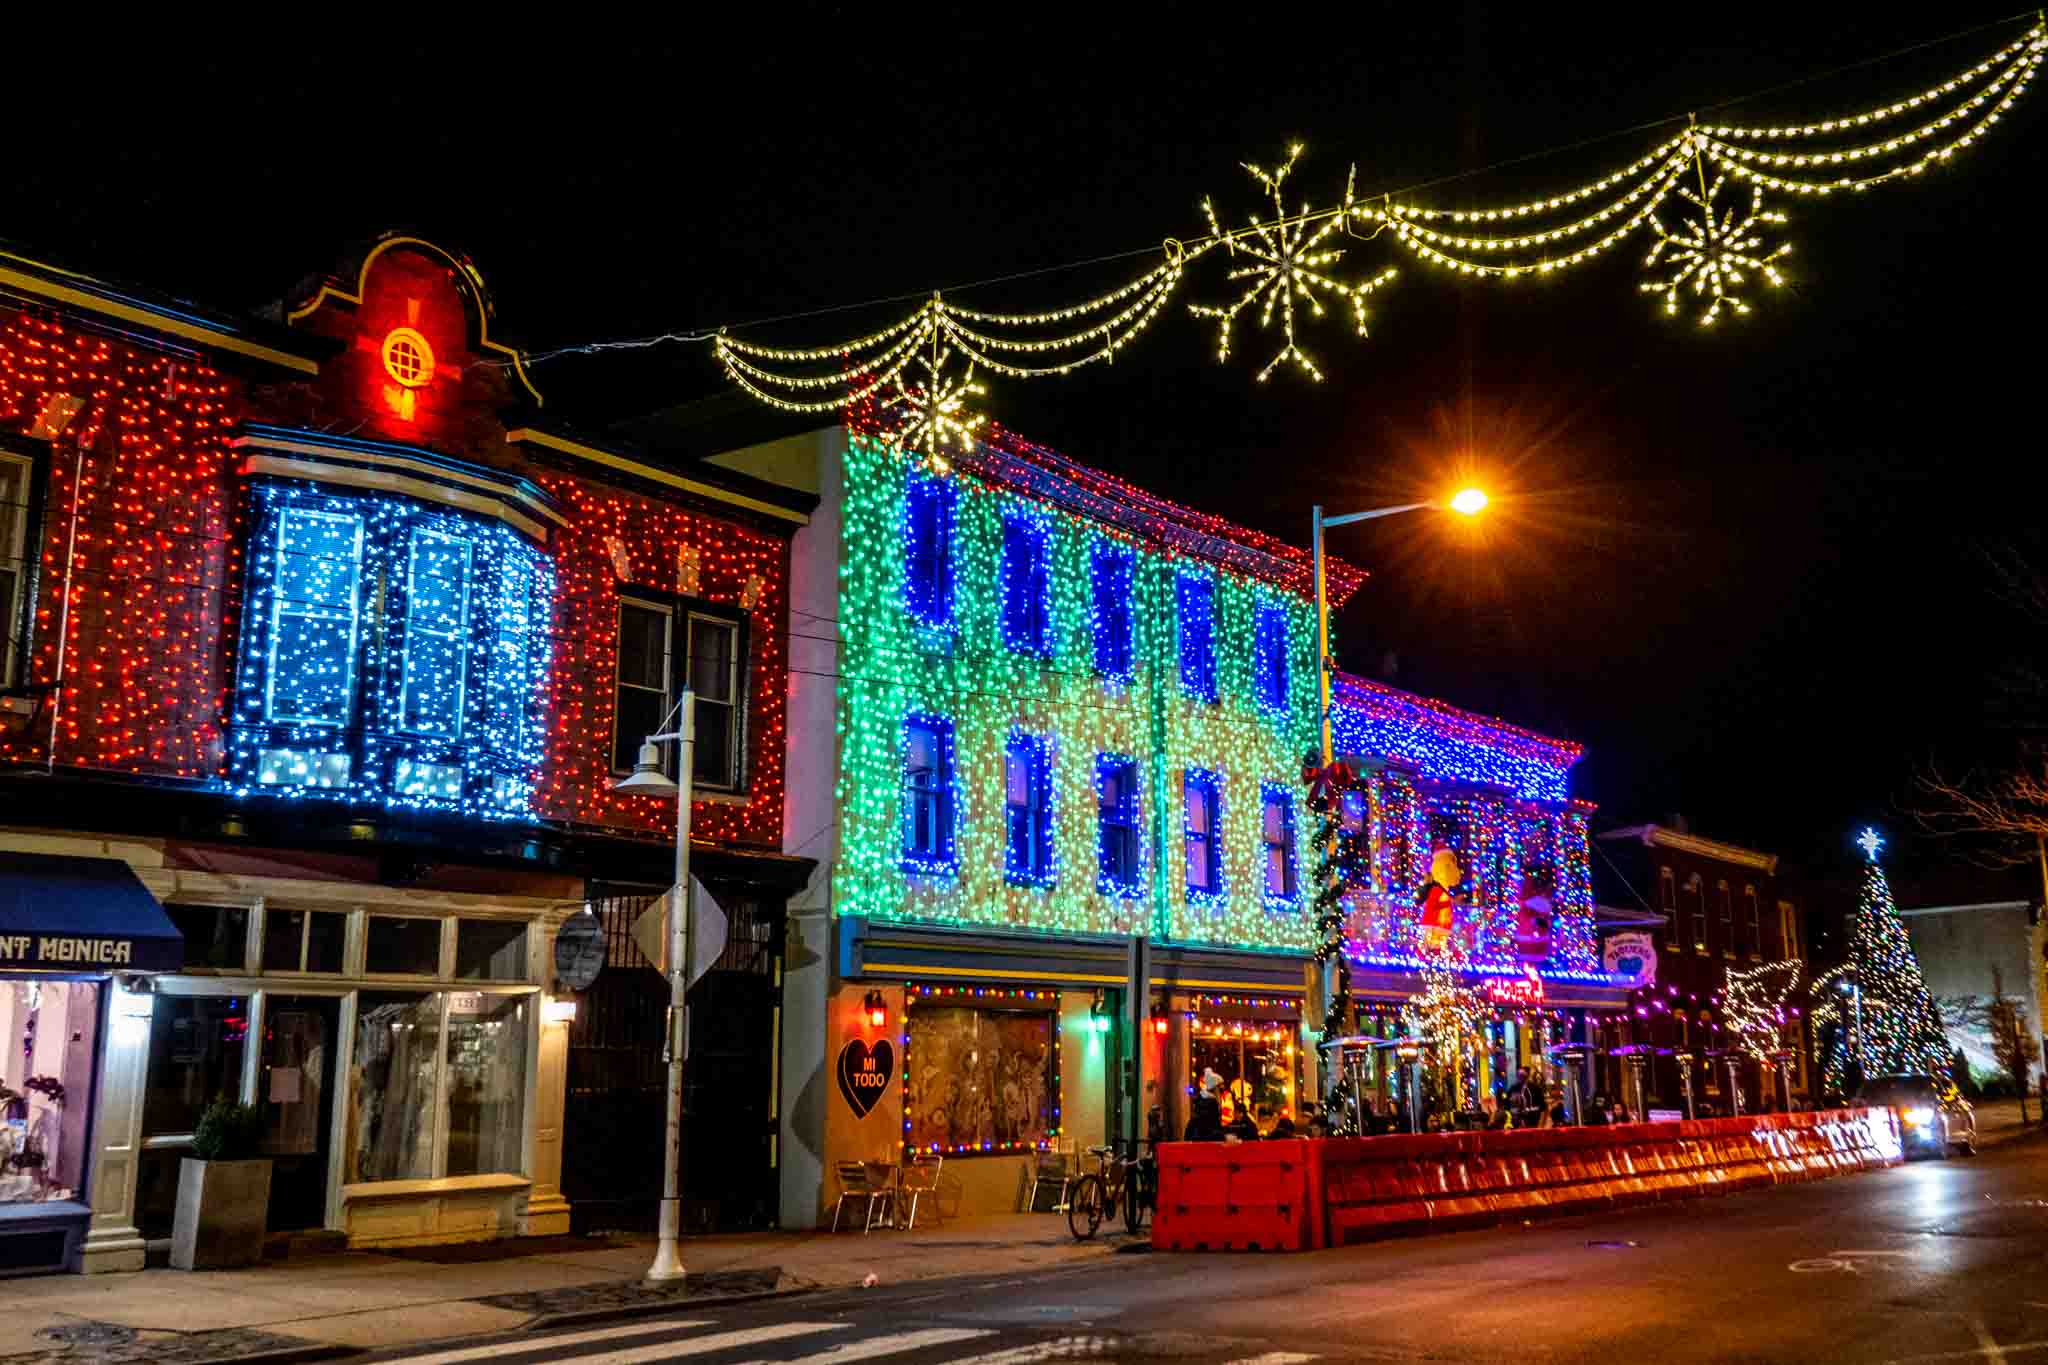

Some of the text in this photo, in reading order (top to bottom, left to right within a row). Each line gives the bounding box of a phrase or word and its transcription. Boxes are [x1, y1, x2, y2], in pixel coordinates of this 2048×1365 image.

[38, 937, 132, 963] MONICA
[863, 1056, 876, 1072] MI
[853, 1072, 885, 1088] TODO
